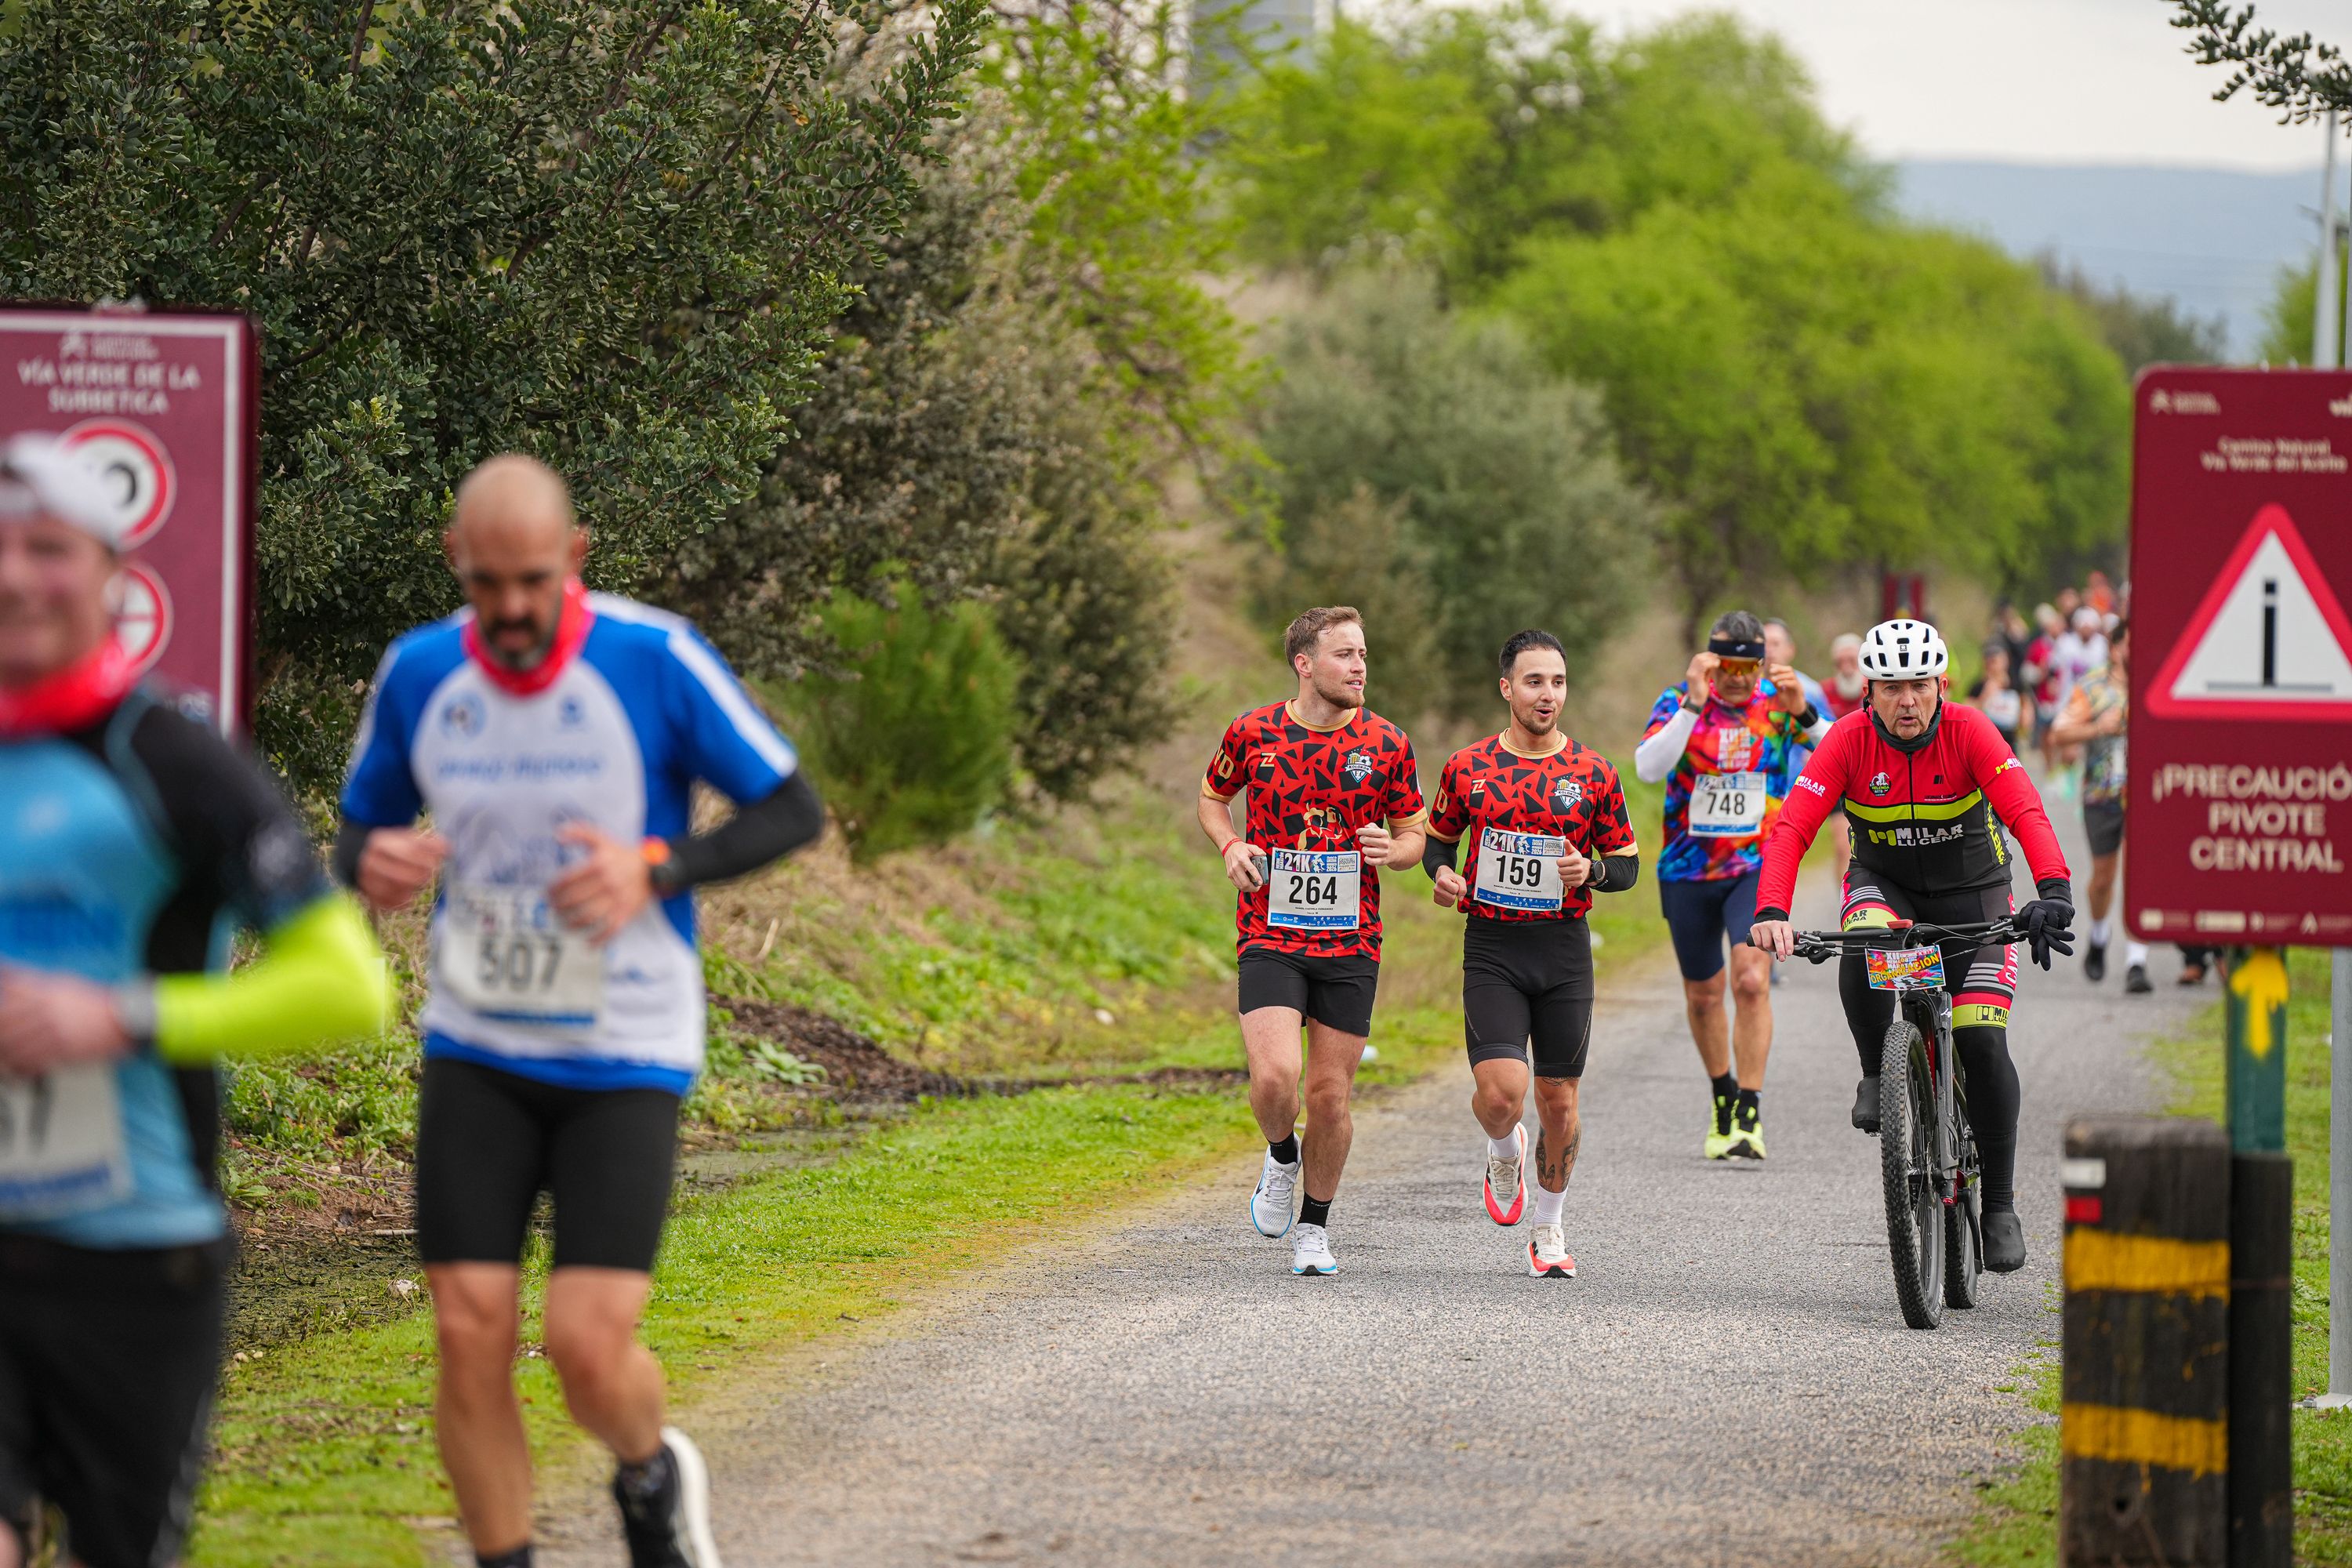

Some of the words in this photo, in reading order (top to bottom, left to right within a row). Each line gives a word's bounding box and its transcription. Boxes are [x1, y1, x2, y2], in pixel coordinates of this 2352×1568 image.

[2152, 760, 2352, 803] ¡PRECAUCIÓ
[1706, 792, 1746, 816] 748
[2208, 800, 2326, 837] PIVOTE
[1490, 832, 1516, 852] 21K
[1896, 824, 1963, 839] MILAR
[1897, 834, 1964, 846] LUCENA
[1285, 853, 1311, 872] 21K
[2189, 835, 2344, 873] CENTRAL
[1496, 855, 1541, 887] 159
[1289, 875, 1338, 905] 264
[479, 942, 561, 993] 507
[1871, 953, 1940, 984] ORGANIZACIÓN
